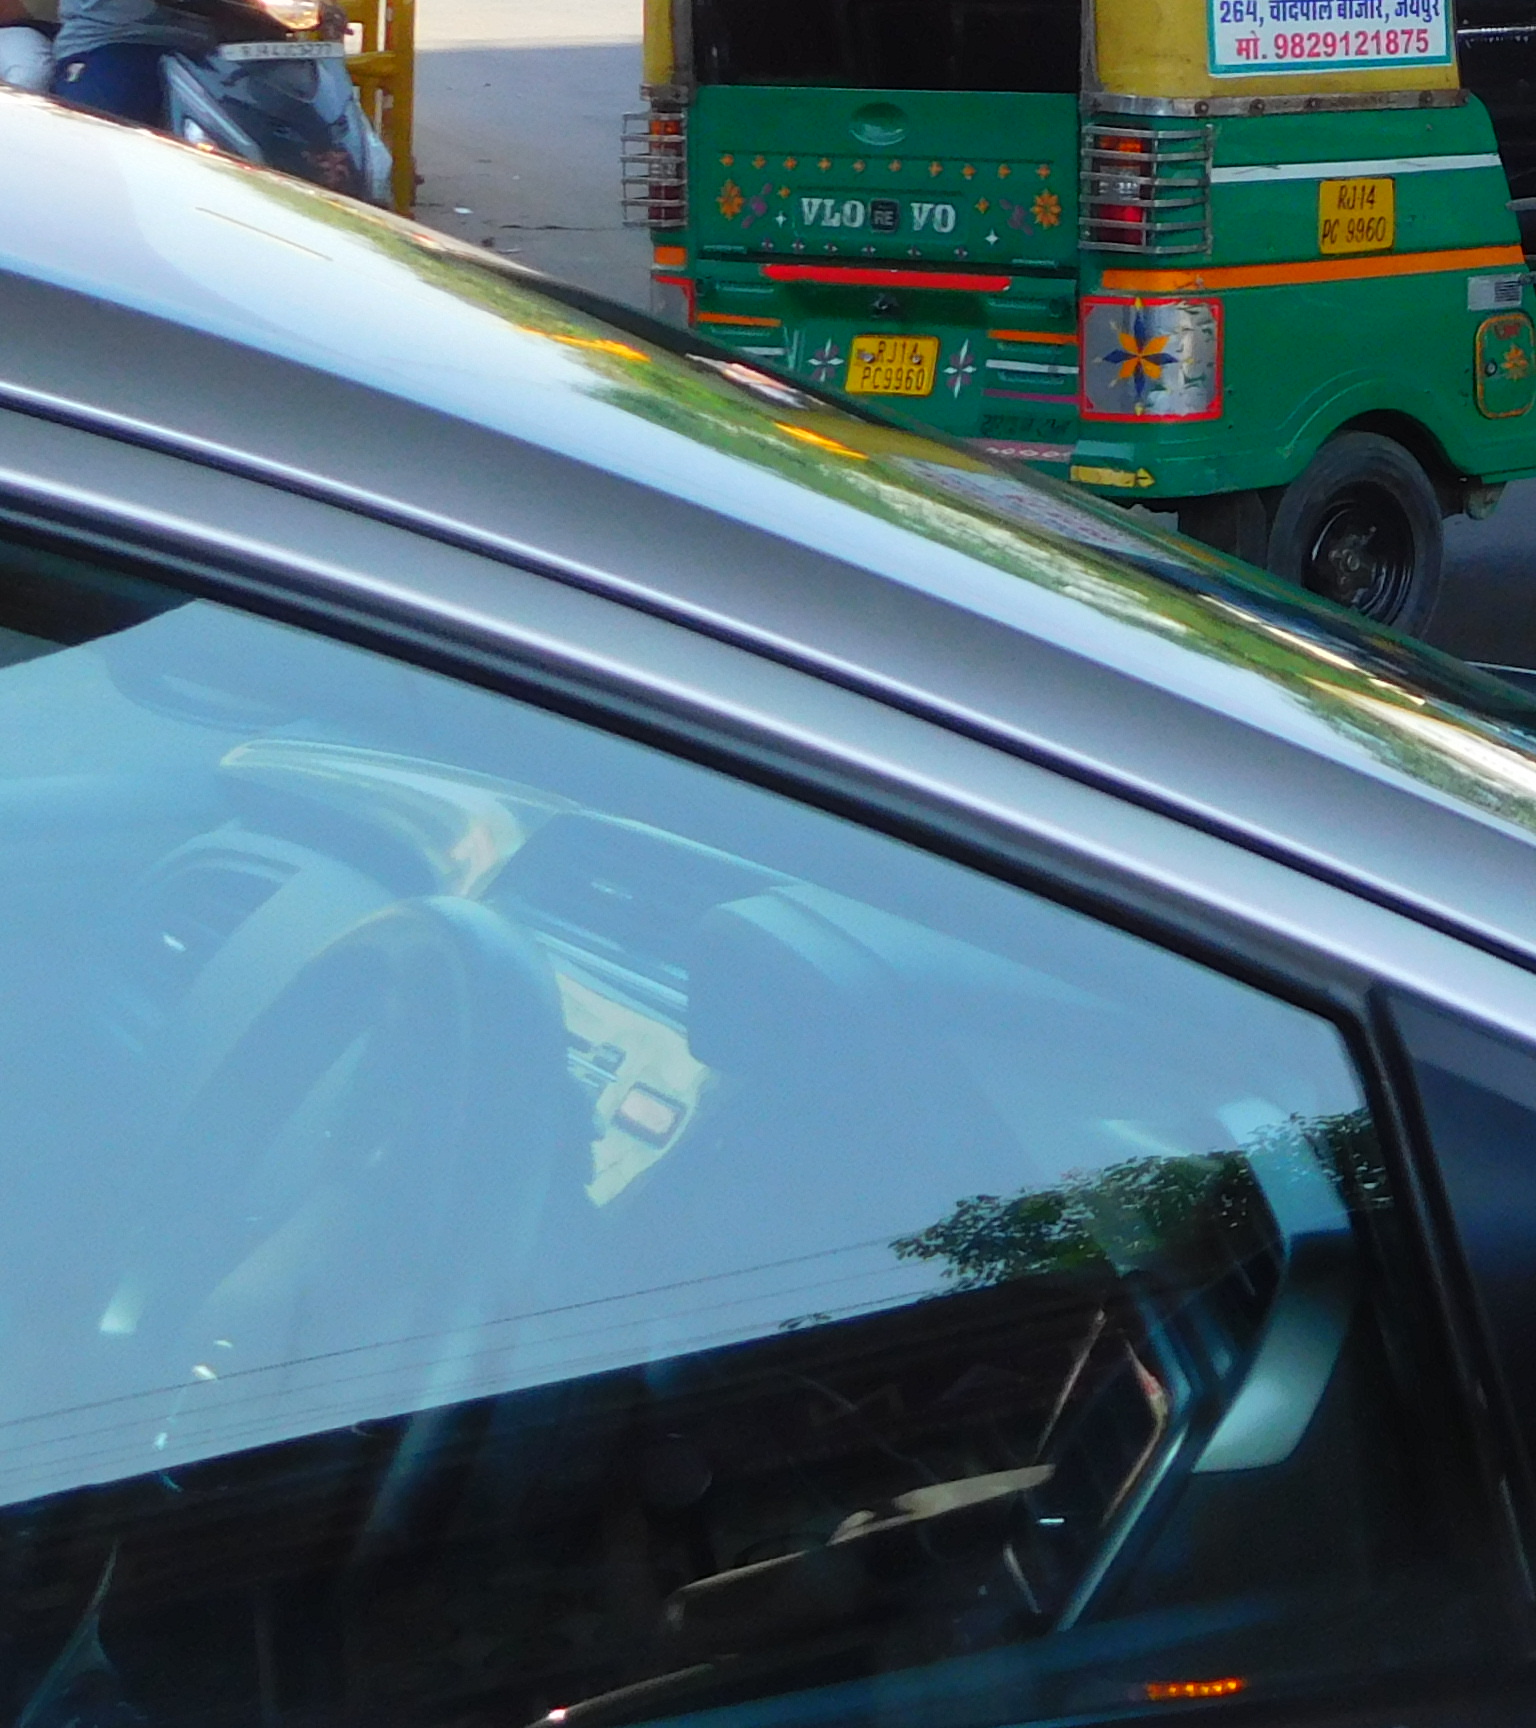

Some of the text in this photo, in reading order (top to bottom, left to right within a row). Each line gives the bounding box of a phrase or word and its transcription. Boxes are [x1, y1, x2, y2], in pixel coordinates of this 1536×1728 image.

[1274, 28, 1430, 59] 9829121875
[801, 197, 956, 233] VLO VO
[1322, 216, 1386, 246] PC 9960
[861, 366, 925, 390] PC9960
